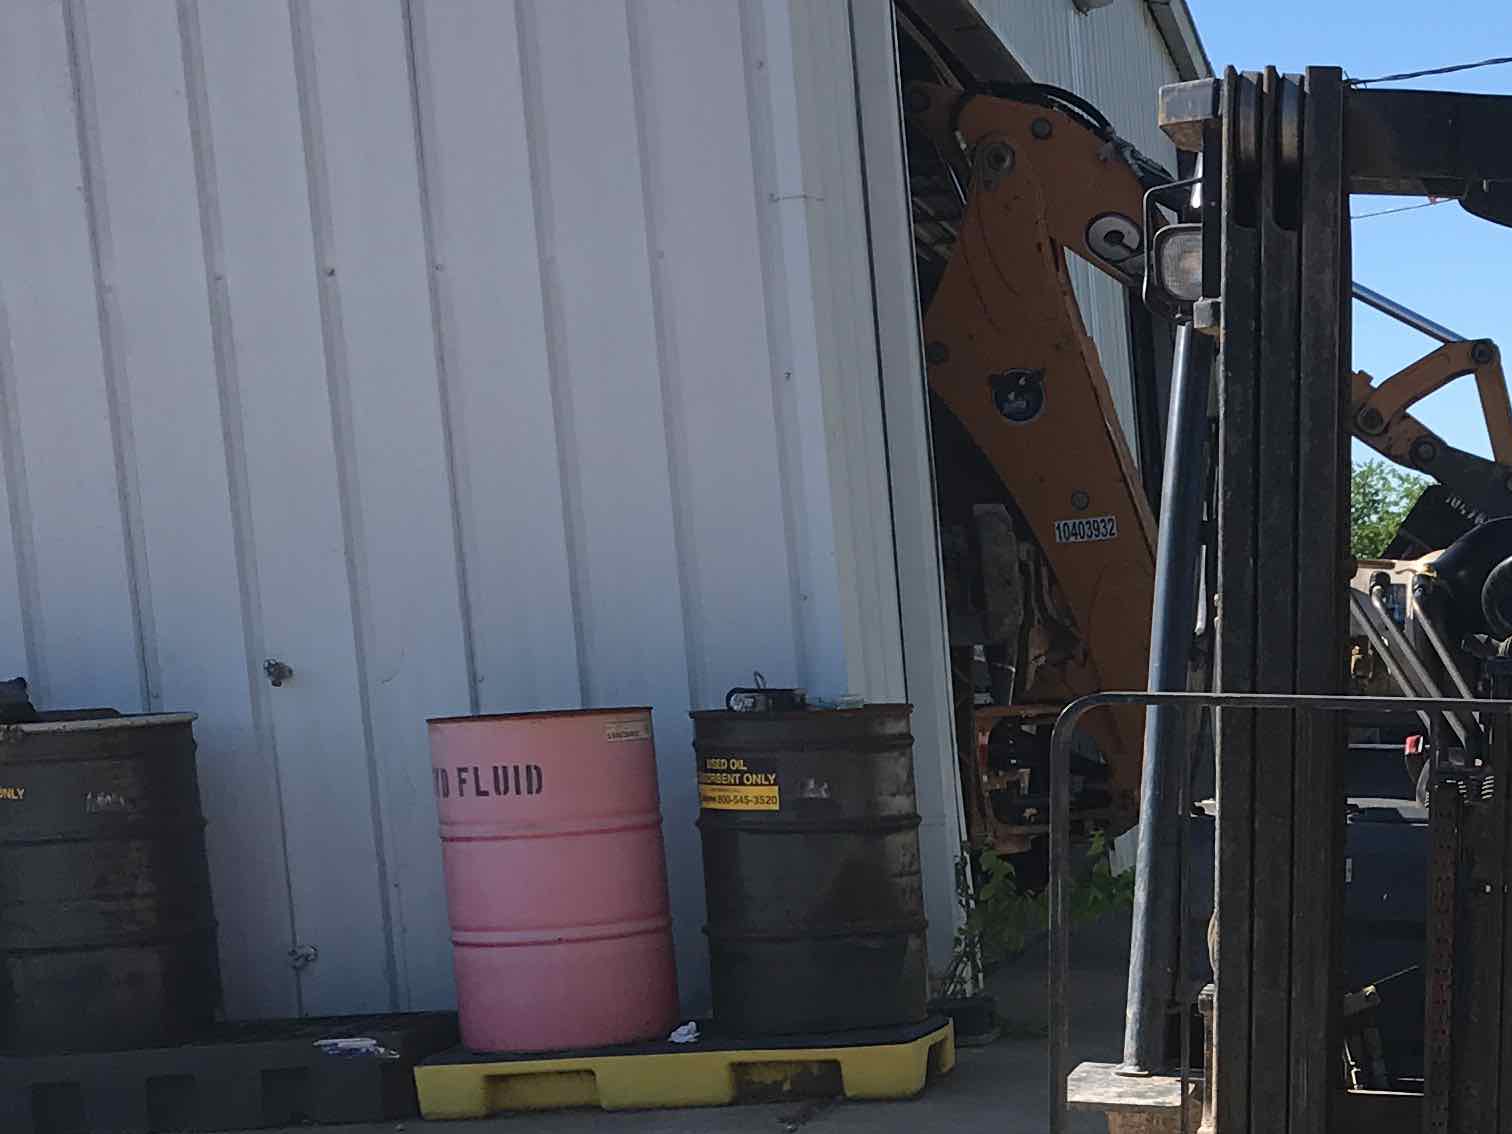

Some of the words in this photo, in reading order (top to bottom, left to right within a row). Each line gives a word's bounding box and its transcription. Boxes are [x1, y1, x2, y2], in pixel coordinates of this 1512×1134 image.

[1056, 518, 1116, 541] 10403932
[706, 759, 728, 769] USED
[729, 759, 748, 770] OIL
[457, 764, 544, 798] FLUID
[743, 773, 776, 785] ONLY
